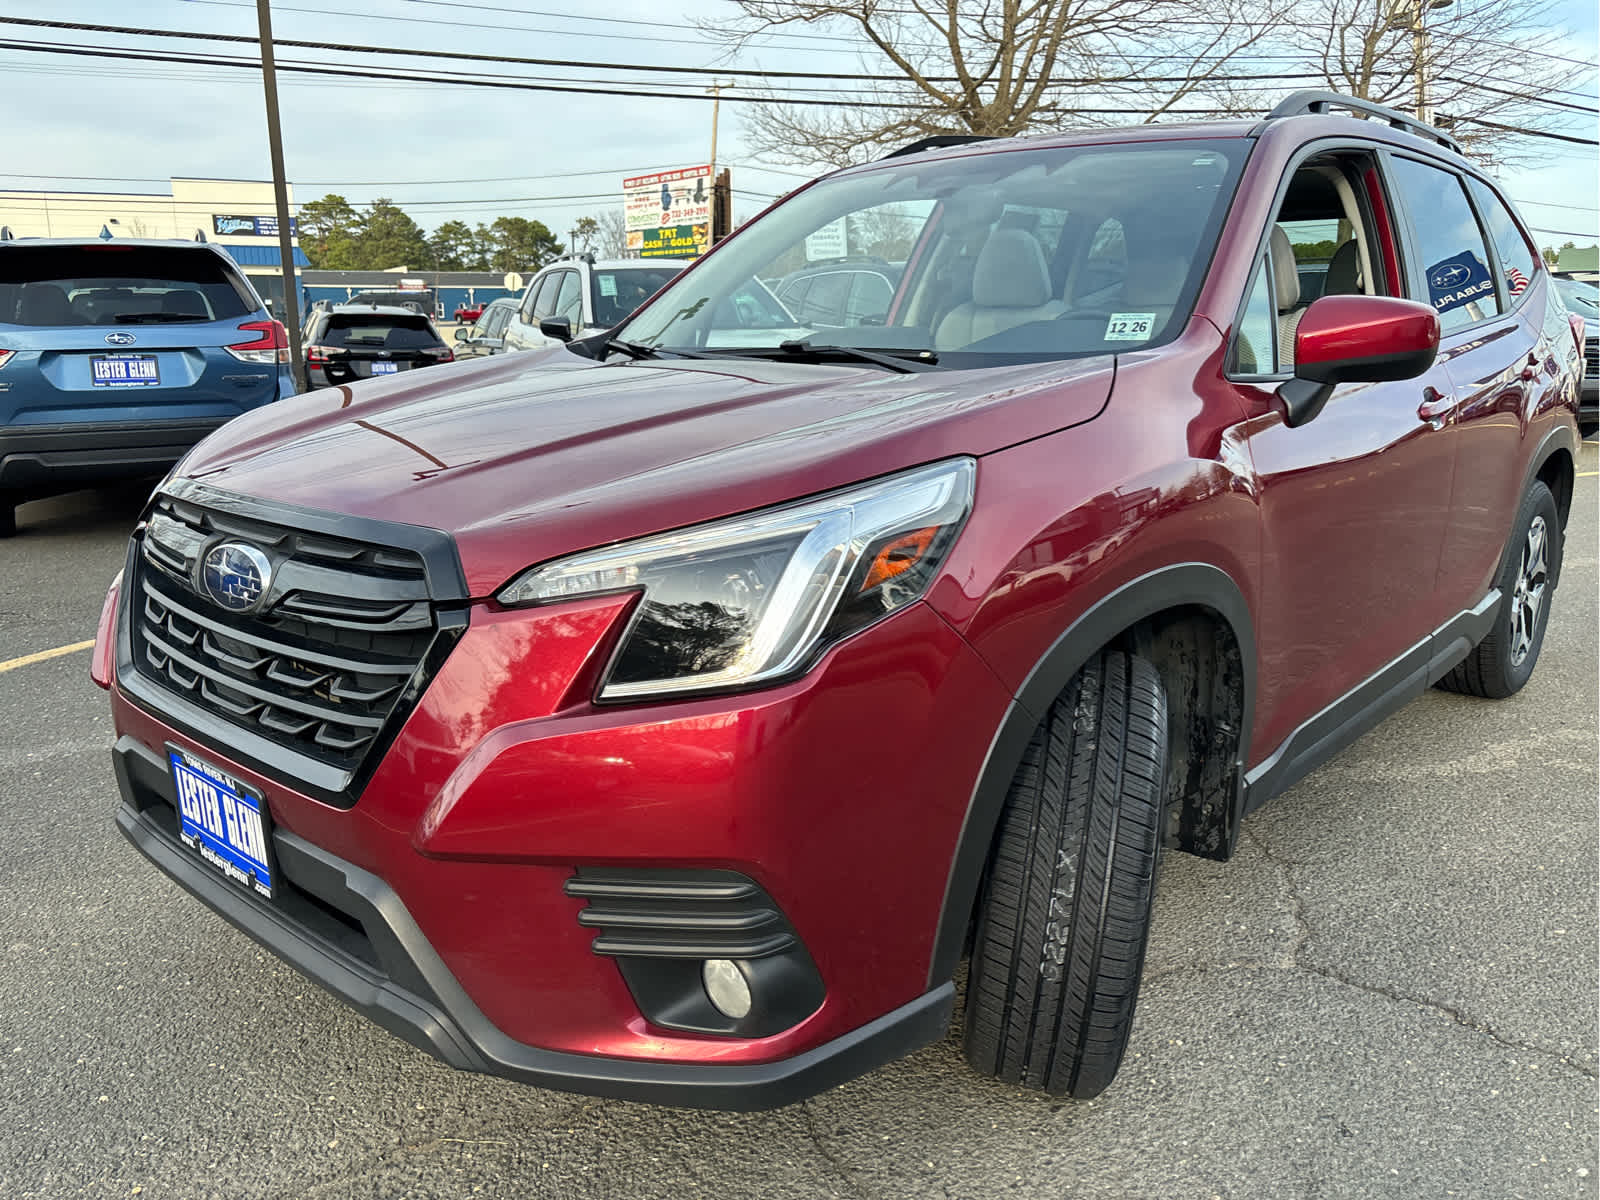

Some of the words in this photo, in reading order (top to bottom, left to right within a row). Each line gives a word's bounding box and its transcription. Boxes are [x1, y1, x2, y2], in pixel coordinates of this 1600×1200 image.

[658, 228, 677, 239] TMT
[643, 240, 663, 248] CASH
[670, 237, 693, 247] GOLD
[1110, 322, 1127, 333] 12
[1131, 321, 1148, 332] 26
[94, 361, 127, 378] LESTER
[128, 361, 157, 378] GLENN
[175, 766, 224, 839] LESTER
[222, 793, 268, 867] GLENN
